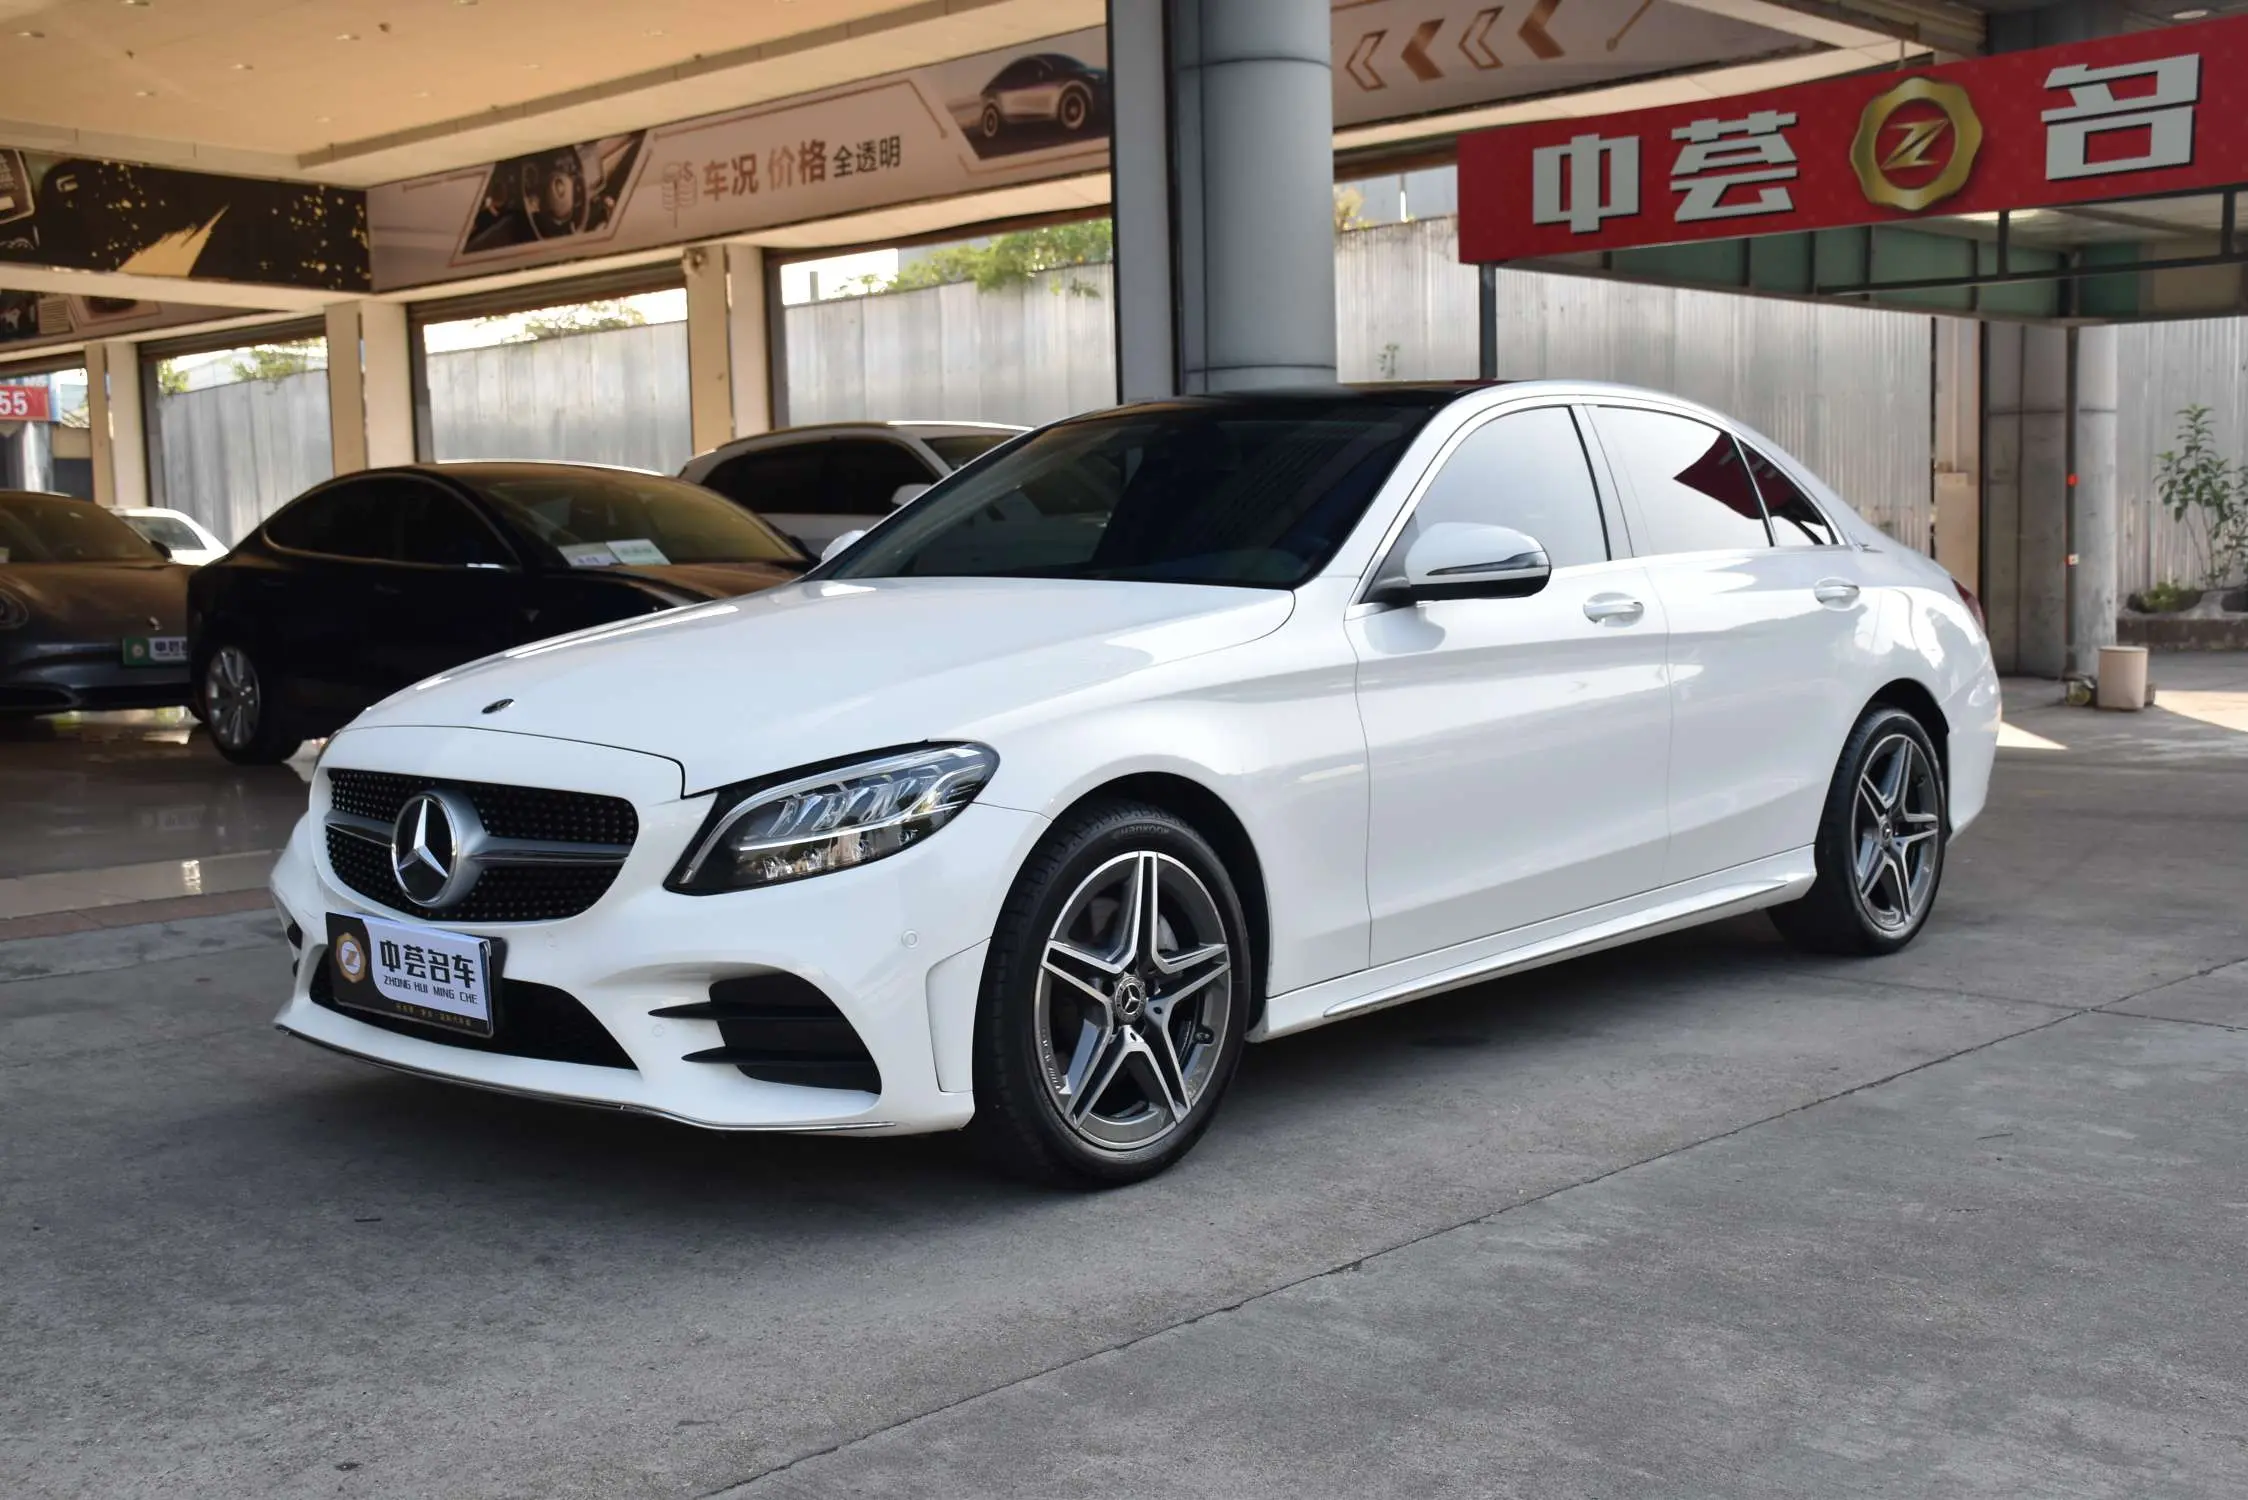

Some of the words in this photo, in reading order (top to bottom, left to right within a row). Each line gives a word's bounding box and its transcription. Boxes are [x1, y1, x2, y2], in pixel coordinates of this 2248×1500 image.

[2041, 53, 2201, 180] 名
[703, 153, 760, 201] 车况
[768, 139, 827, 191] 价格
[833, 135, 901, 178] 全透明
[0, 390, 28, 416] 55
[379, 940, 476, 989] 中荟名车
[384, 975, 412, 990] ZHONG
[413, 981, 429, 994] HUI
[432, 985, 455, 1000] MING
[459, 991, 478, 1005] CHE
